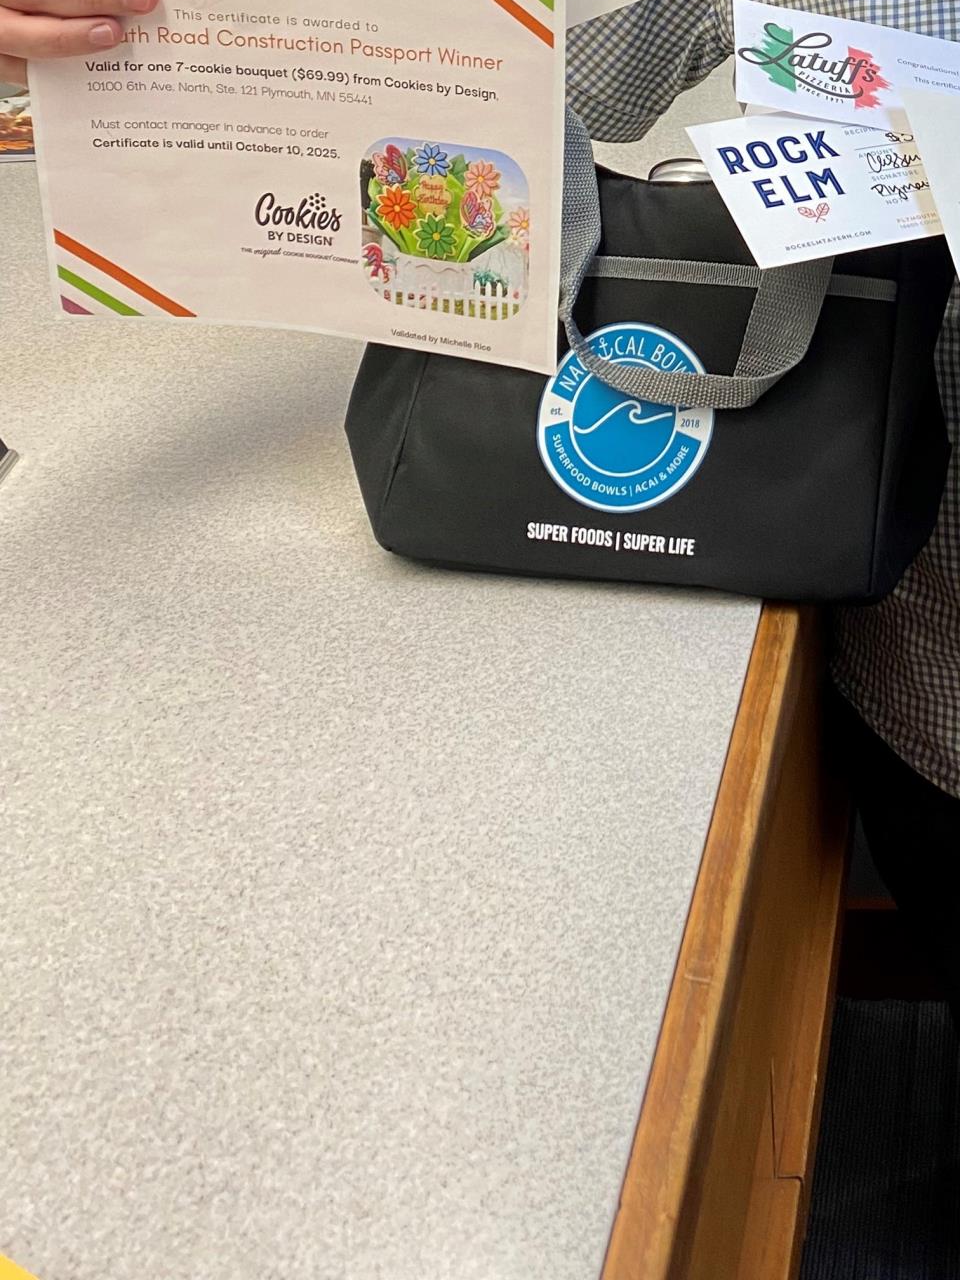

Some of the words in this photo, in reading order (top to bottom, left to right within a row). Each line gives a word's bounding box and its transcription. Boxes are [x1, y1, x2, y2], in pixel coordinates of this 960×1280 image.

[174, 9, 201, 20] This
[208, 12, 280, 25] certificate
[286, 15, 297, 26] is
[303, 17, 360, 31] awarded
[366, 22, 378, 33] to
[120, 25, 149, 43] uth
[158, 27, 209, 45] Road
[217, 29, 343, 54] Construction
[351, 38, 432, 65] Passport
[437, 47, 503, 70] Winner
[738, 22, 877, 99] Latuff's
[896, 58, 959, 77] Congratulations!
[86, 61, 119, 72] Valid
[124, 61, 143, 72] for
[148, 63, 171, 72] one
[176, 61, 232, 74] 7-cookie
[236, 65, 288, 80] bouquet
[291, 68, 349, 86] ($69.99)
[353, 74, 381, 86] from
[384, 76, 433, 92] Cookies
[436, 82, 451, 96] by
[798, 71, 850, 94] PIZZERIA
[914, 76, 930, 85] This
[87, 81, 122, 91] 10100
[126, 81, 146, 91] 6th
[216, 84, 238, 94] Ste.
[240, 85, 257, 95] 121
[261, 86, 314, 101] Plymouth,
[316, 91, 336, 102] MN
[338, 92, 373, 105] 55441
[798, 83, 820, 97] SINCE
[91, 120, 120, 130] Must
[124, 120, 168, 130] contact
[171, 122, 220, 133] manager
[224, 122, 233, 132] in
[236, 123, 282, 135] advance
[285, 126, 296, 136] to
[300, 128, 329, 139] order
[92, 138, 159, 148] Certificate
[162, 138, 173, 148] is
[176, 138, 204, 149] valid
[207, 140, 233, 150] until
[235, 141, 283, 154] October
[287, 145, 304, 156] 10,
[306, 147, 341, 159] 2025.
[717, 130, 841, 175] ROCK
[872, 169, 919, 182] SIGNATURE
[752, 167, 846, 209] ELM
[255, 193, 342, 232] Cookies
[268, 231, 284, 241] BY
[287, 232, 333, 246] DESIGN
[785, 230, 872, 251] ROCKELMTAVERN.COM
[254, 247, 281, 258] original
[391, 329, 427, 341] Validated
[429, 335, 438, 344] by
[440, 337, 472, 349] Michelle
[474, 342, 491, 351] Rice
[550, 407, 563, 416] est.
[680, 418, 700, 428] 2018
[552, 433, 591, 486] SUPERFOOD
[591, 480, 627, 496] BOWLS
[635, 477, 658, 493] ACAI
[659, 472, 668, 481] &
[668, 445, 690, 475] MORE
[527, 522, 568, 542] SUPER
[571, 526, 613, 547] FOODS
[623, 532, 665, 553] SUPER
[668, 536, 696, 556] LIFE
